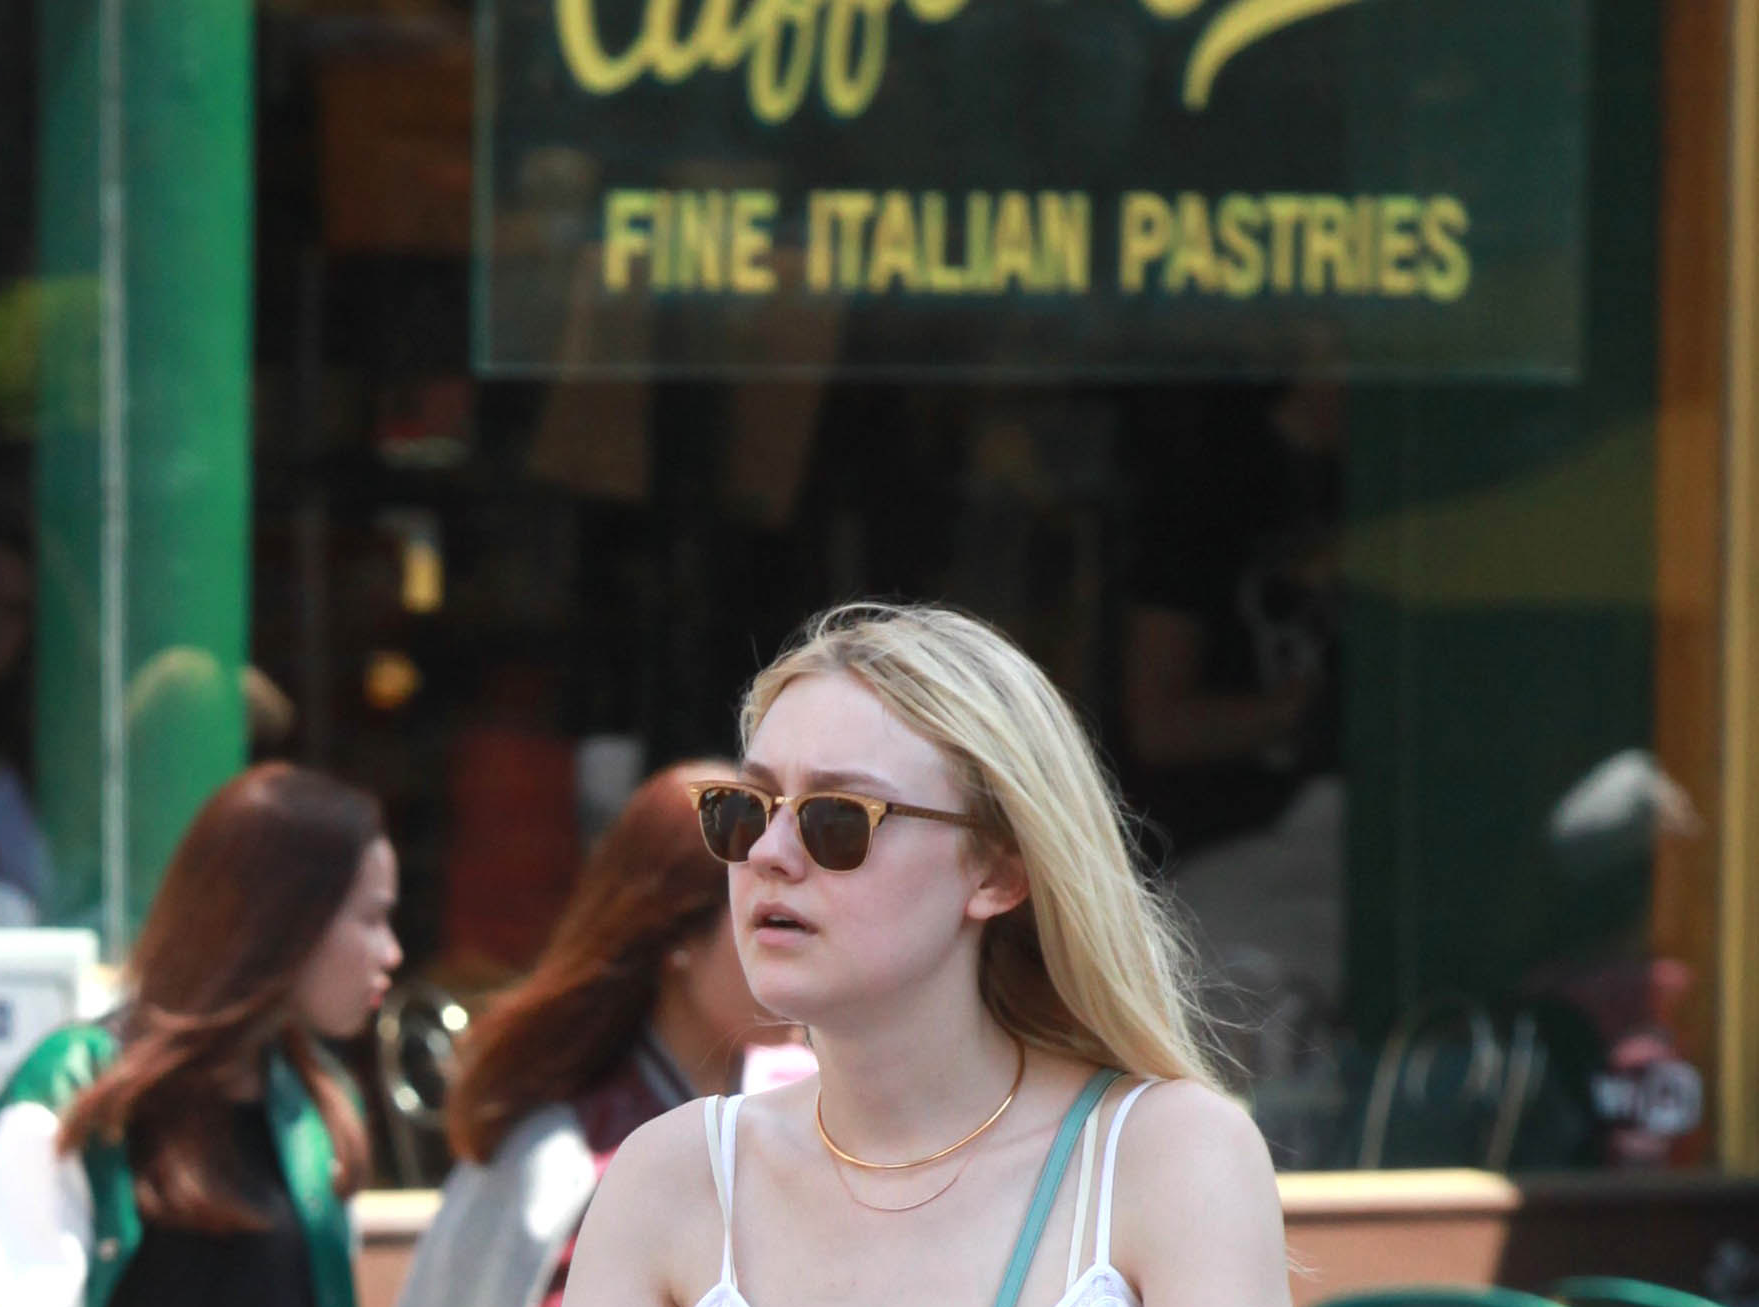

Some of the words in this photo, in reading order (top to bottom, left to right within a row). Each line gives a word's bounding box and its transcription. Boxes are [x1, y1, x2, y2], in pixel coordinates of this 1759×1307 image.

[554, 0, 969, 123] aff
[603, 190, 778, 293] FINE
[806, 190, 1091, 294] ITALIAN
[1120, 192, 1471, 302] PASTRIES
